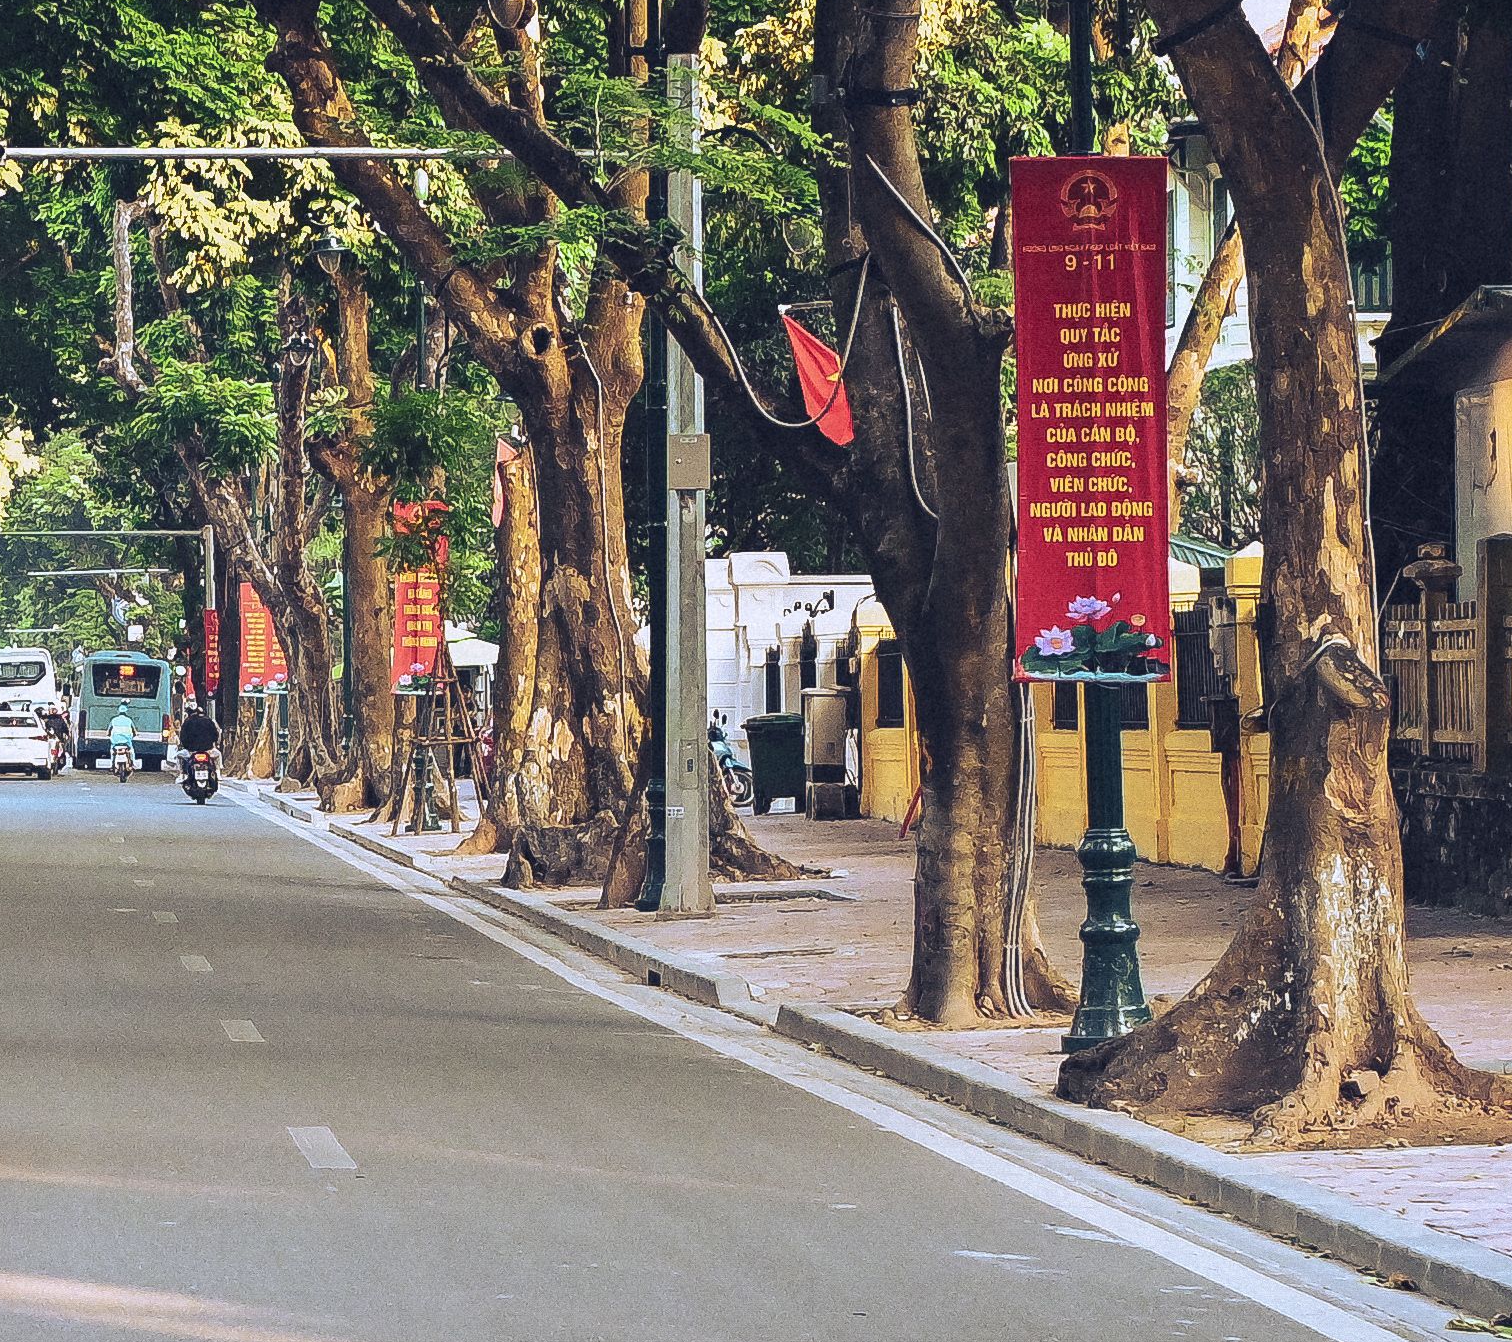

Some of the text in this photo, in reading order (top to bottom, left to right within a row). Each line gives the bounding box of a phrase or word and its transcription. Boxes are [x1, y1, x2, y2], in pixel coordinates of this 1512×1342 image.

[1053, 299, 1131, 322] THỰC HIỆN
[1059, 322, 1121, 345] QUY TẮC
[1063, 347, 1120, 369] ỨNG XỬ
[1032, 373, 1151, 396] NƠI CÔNG CỘNG
[1031, 398, 1155, 421] LÀ TRÁCH NHIỆM
[1046, 422, 1140, 446] CỦA CÁN BỘ,
[1046, 448, 1136, 469] CÔNG CHỨC,
[1049, 473, 1133, 494] VIÊN CHỨC,
[1029, 498, 1154, 521] NGƯỜI LAO ĐỘNG
[1042, 523, 1145, 543] VÀ NHÂN DÂN
[1065, 546, 1118, 567] THỦ ĐÔ
